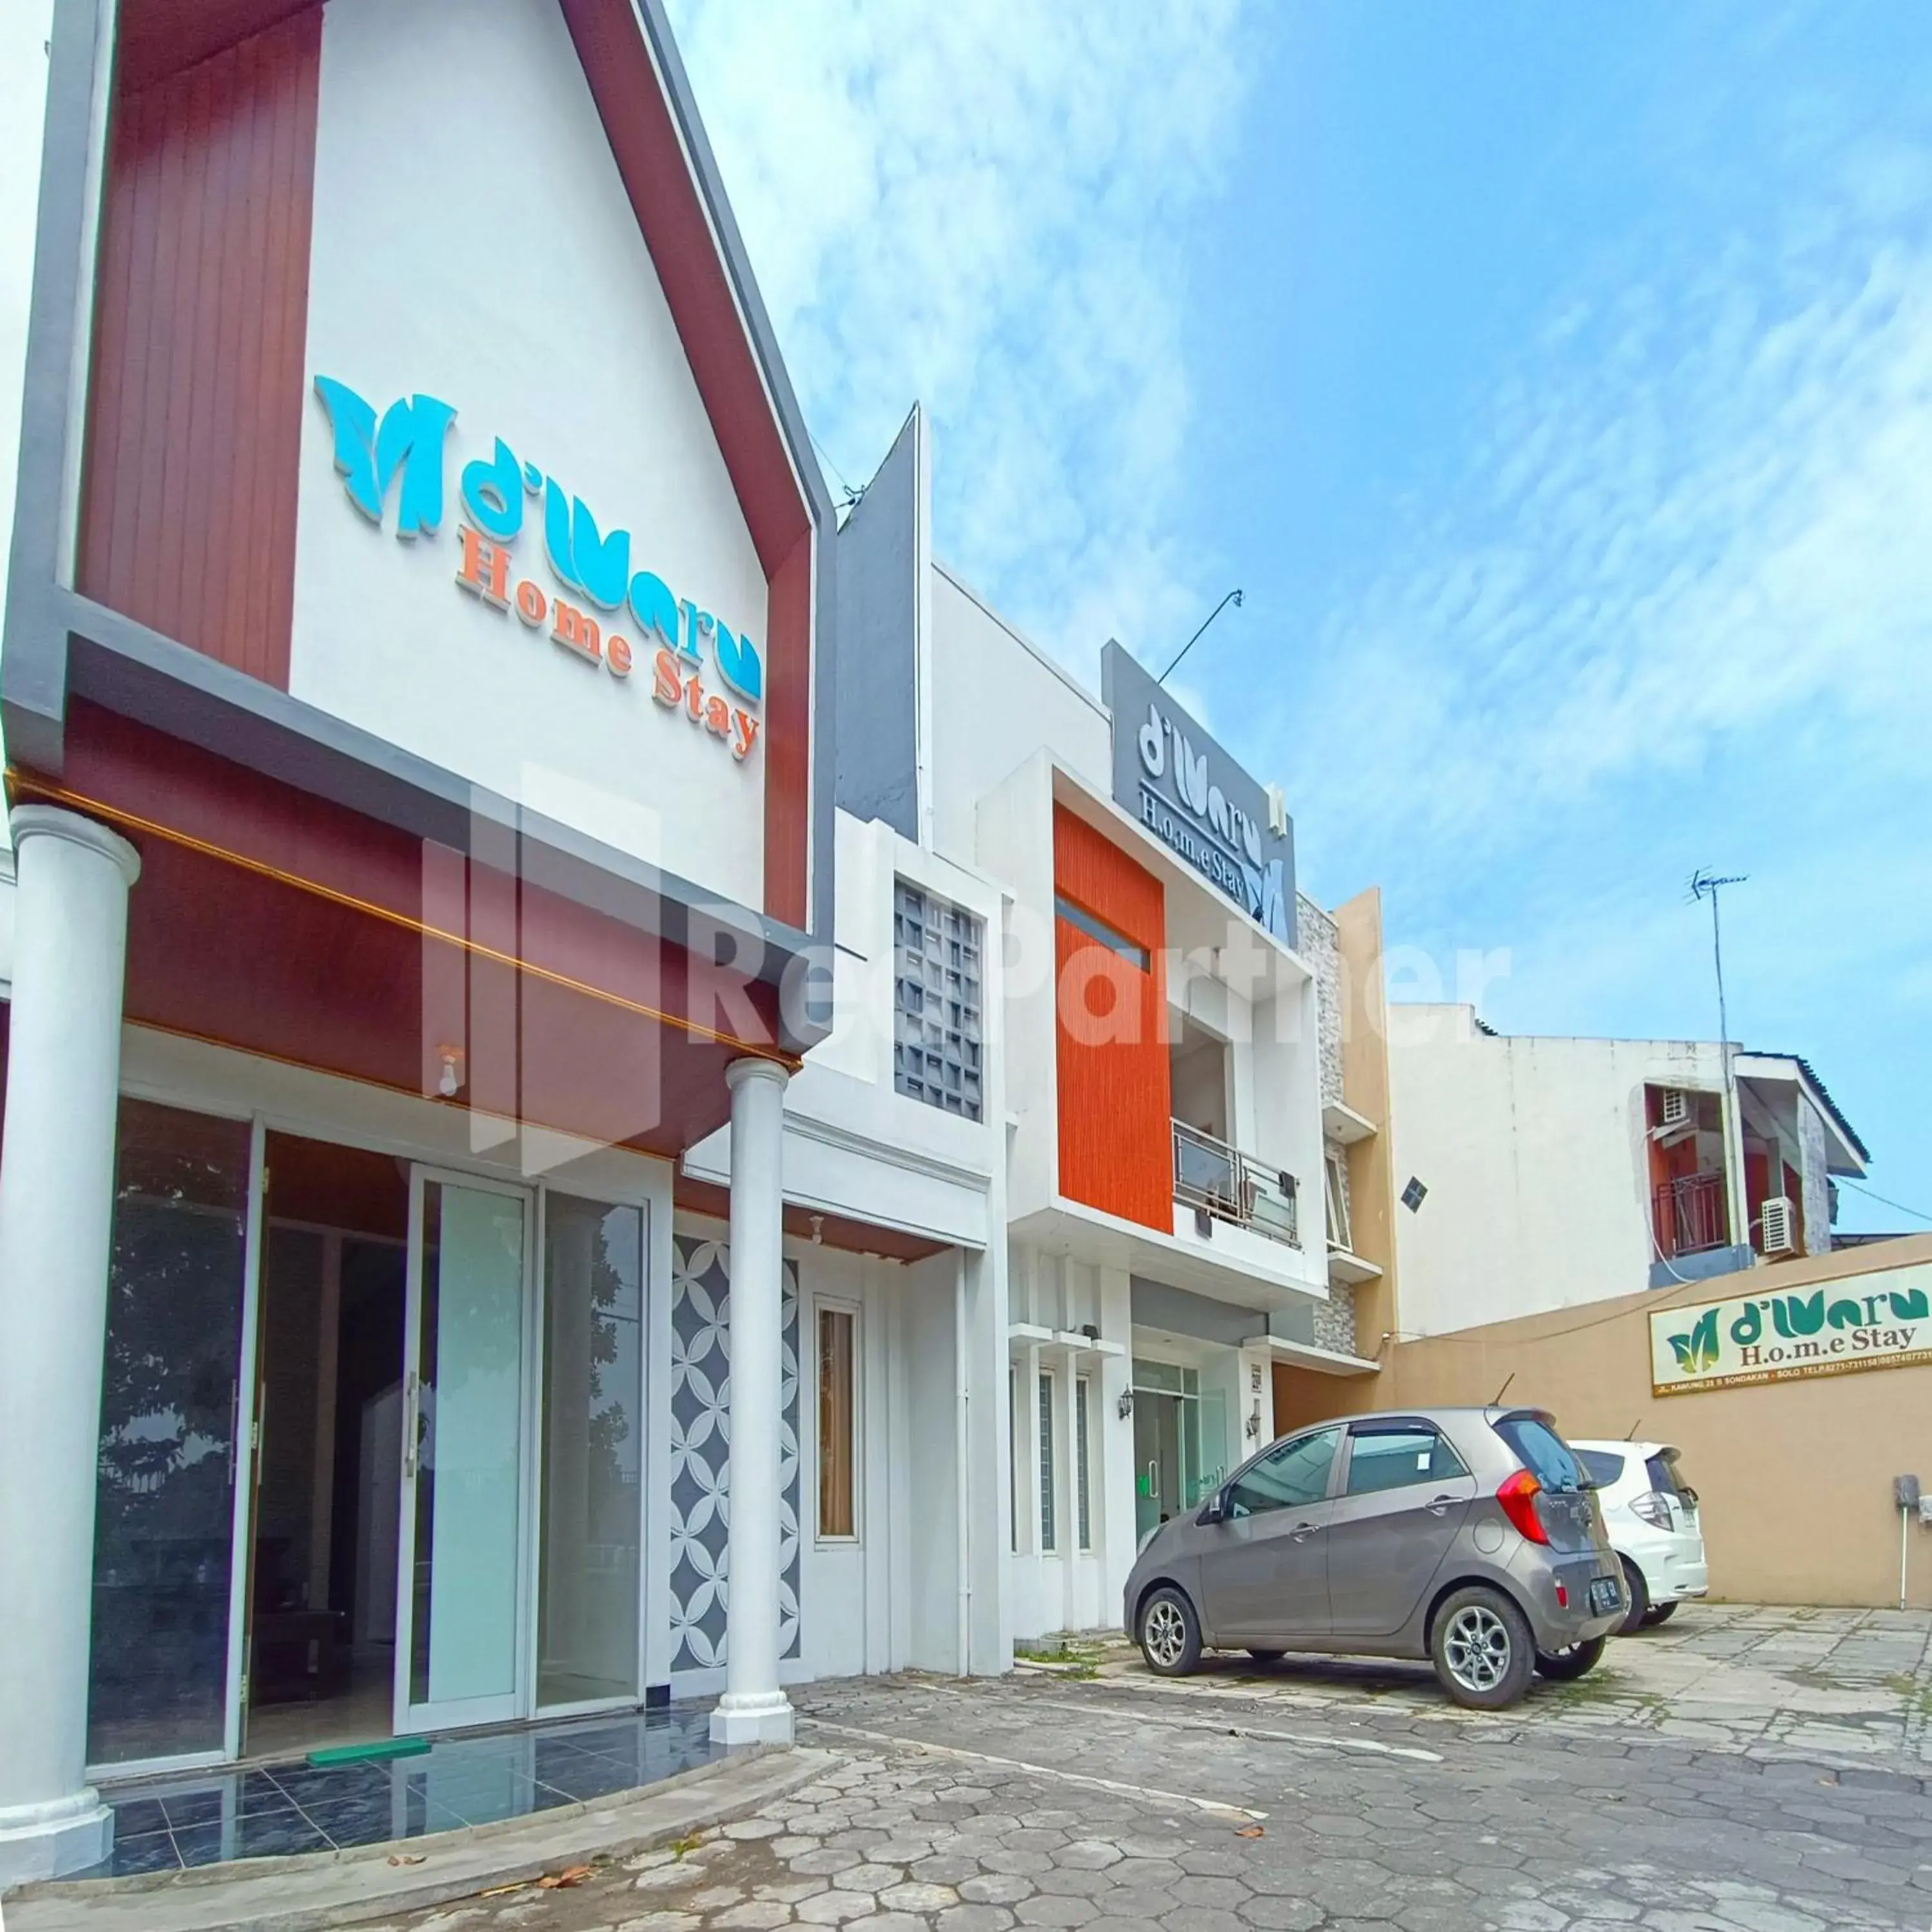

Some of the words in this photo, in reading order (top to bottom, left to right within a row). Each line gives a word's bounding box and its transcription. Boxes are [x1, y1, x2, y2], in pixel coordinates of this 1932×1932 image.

[455, 524, 632, 677] Home
[652, 648, 760, 761] Stay
[1212, 851, 1244, 903] Stay
[1852, 1327, 1917, 1350] Stay
[1777, 1367, 1800, 1378] SOLO
